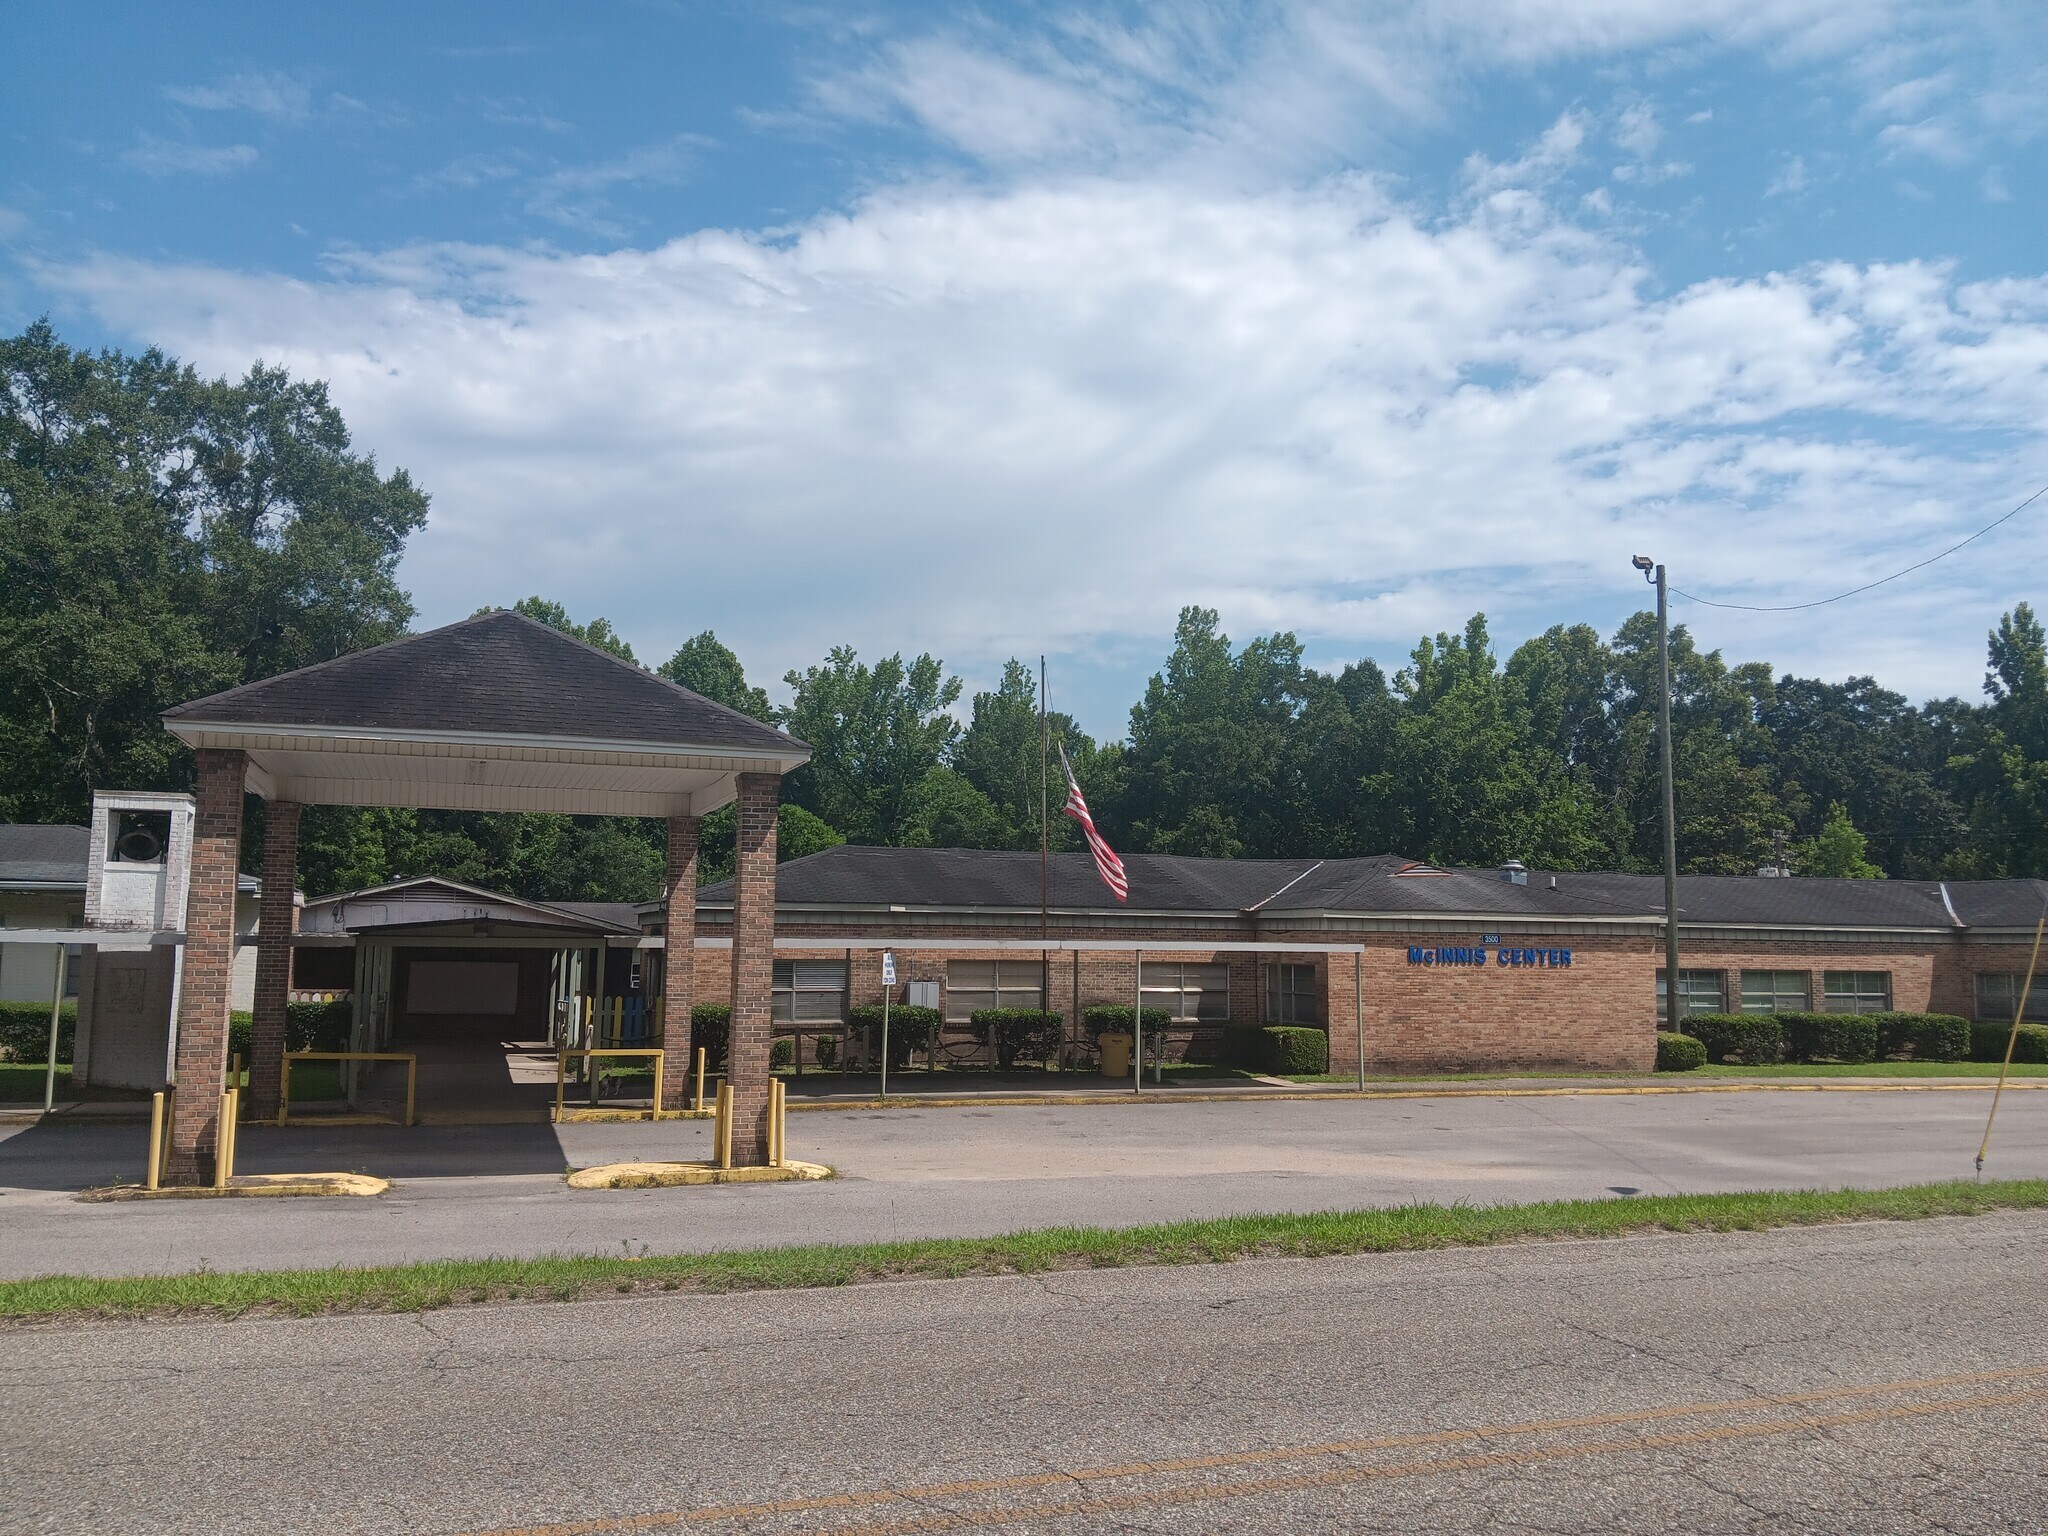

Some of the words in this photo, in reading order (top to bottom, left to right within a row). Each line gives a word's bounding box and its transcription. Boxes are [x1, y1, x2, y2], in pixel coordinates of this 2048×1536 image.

[1484, 935, 1499, 943] 3500
[1408, 946, 1487, 965] McINNIS
[1497, 947, 1572, 965] CENTER
